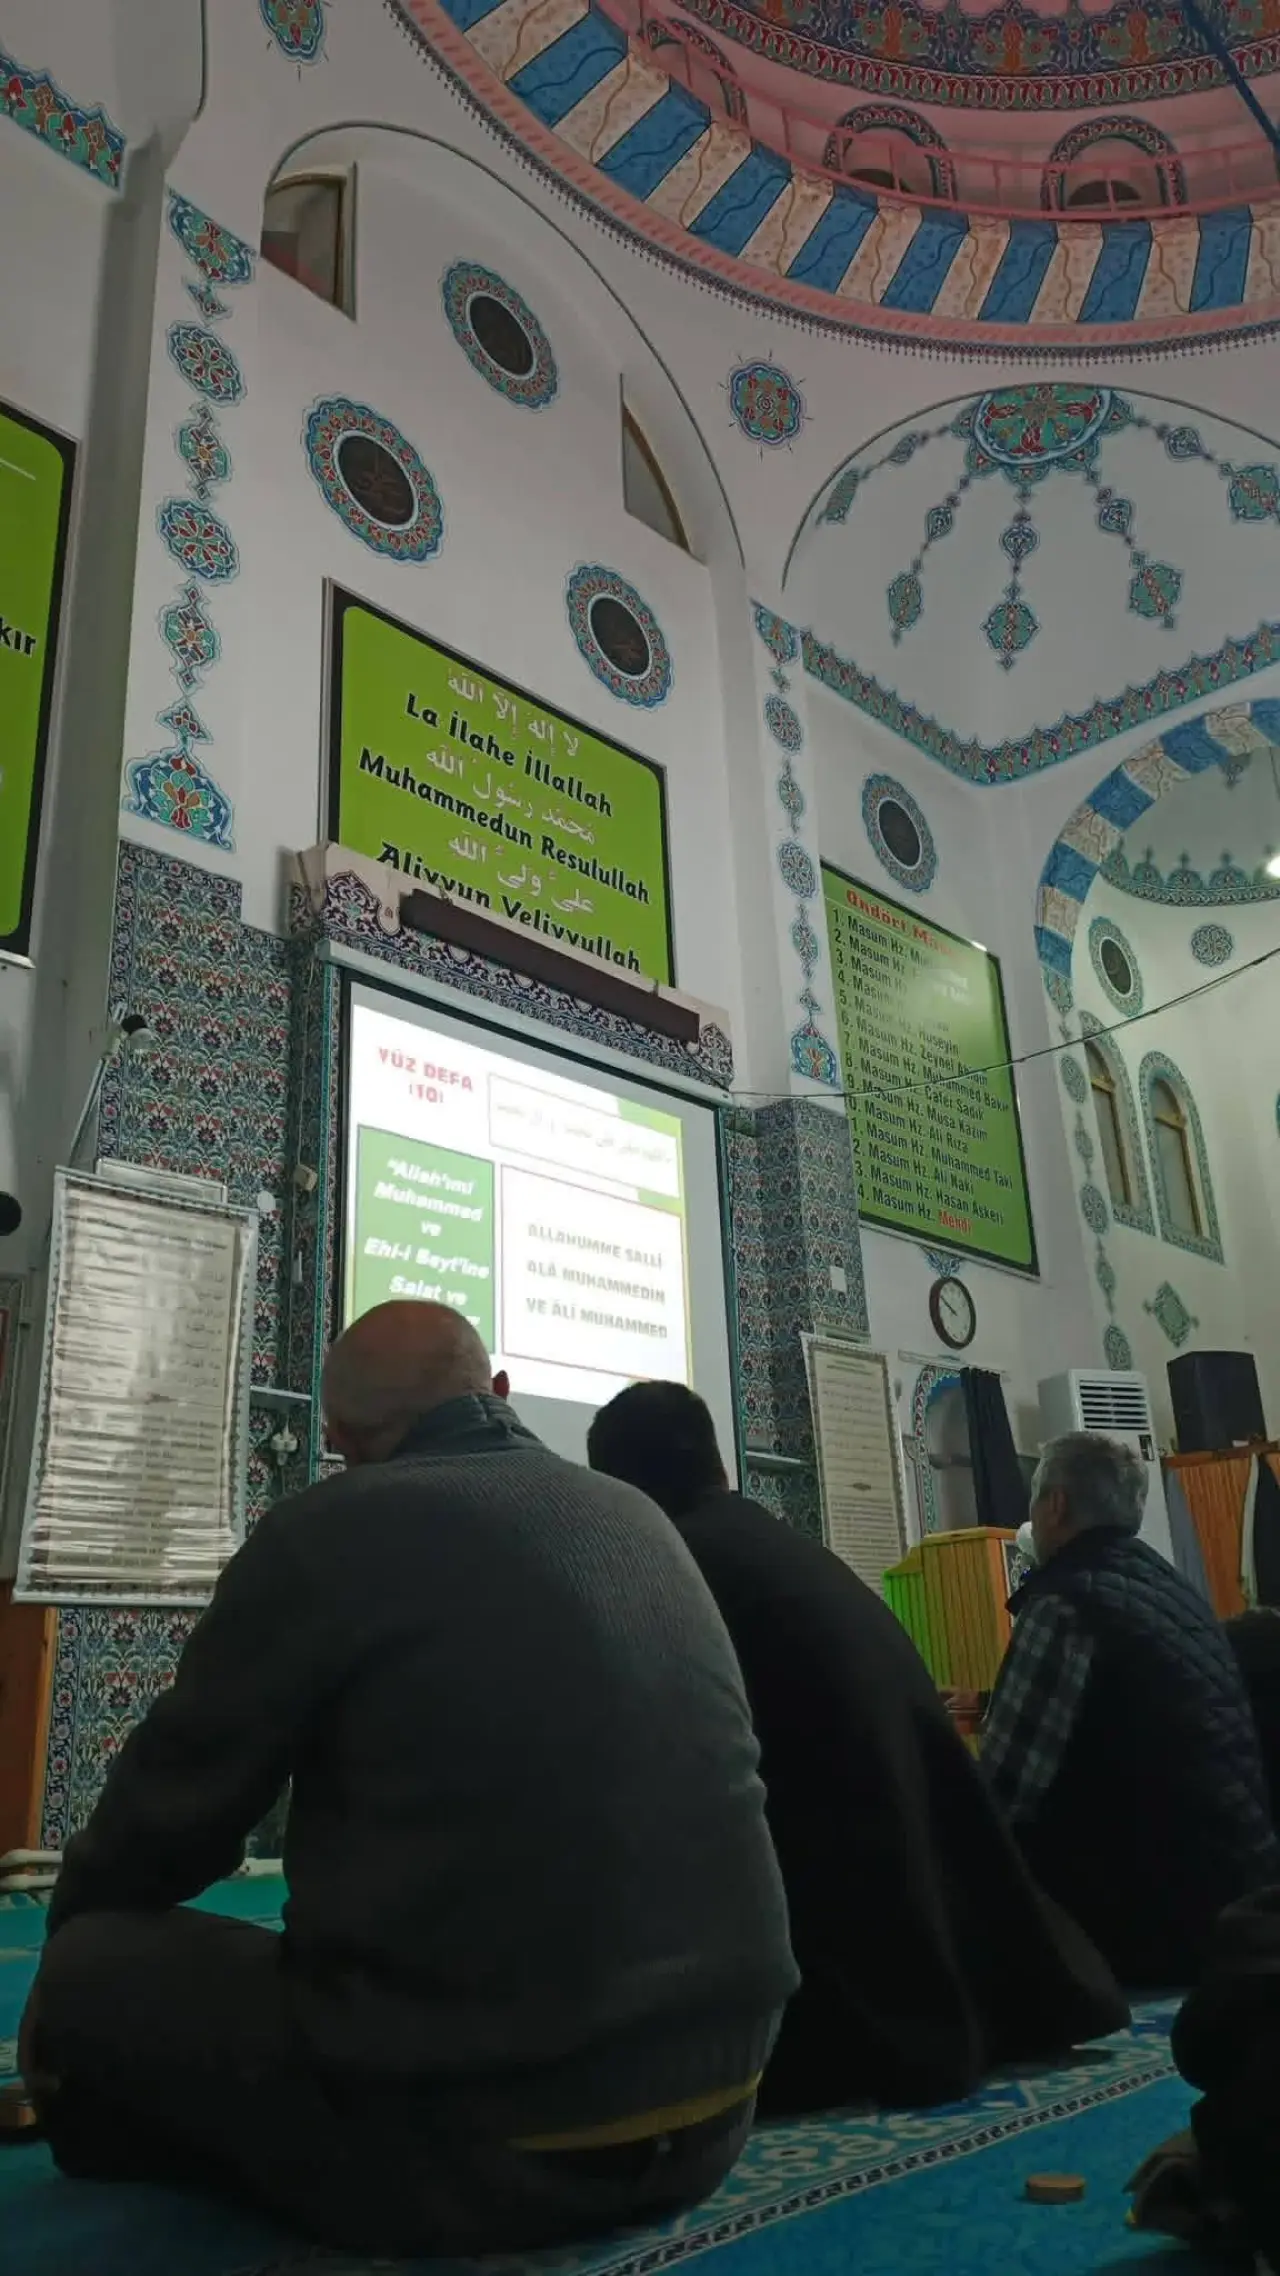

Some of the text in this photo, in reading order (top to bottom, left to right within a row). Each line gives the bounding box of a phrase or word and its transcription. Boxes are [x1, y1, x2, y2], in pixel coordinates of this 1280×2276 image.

[0, 616, 36, 655] kır
[407, 693, 438, 727] La
[359, 747, 650, 905] Muhammedun Resulullah
[833, 909, 844, 927] 1.
[848, 915, 888, 948] Masum
[835, 929, 846, 946] 2.
[849, 936, 889, 968] Masum
[836, 949, 848, 966] 3.
[851, 956, 891, 987] Masum
[838, 970, 850, 986] 4.
[856, 1016, 898, 1046] Masum
[858, 1037, 900, 1067] Masum
[424, 1062, 472, 1092] DEFA
[845, 1052, 858, 1070] 8.
[861, 1058, 901, 1087] Masum
[863, 1079, 903, 1107] Masum
[865, 1100, 905, 1128] Masum
[866, 1120, 907, 1149] Masum
[931, 1147, 990, 1181] Muhammed
[869, 1141, 910, 1170] Masum
[374, 1181, 483, 1222] Muhammed
[871, 1165, 912, 1193] Masum
[936, 1189, 969, 1213] Hasan
[872, 1186, 914, 1214] Masum
[420, 1220, 442, 1237] ve
[528, 1223, 621, 1259] ALLAHUMME
[447, 1290, 468, 1306] ve
[526, 1297, 547, 1315] VE
[580, 1308, 668, 1338] MUHAMMED
